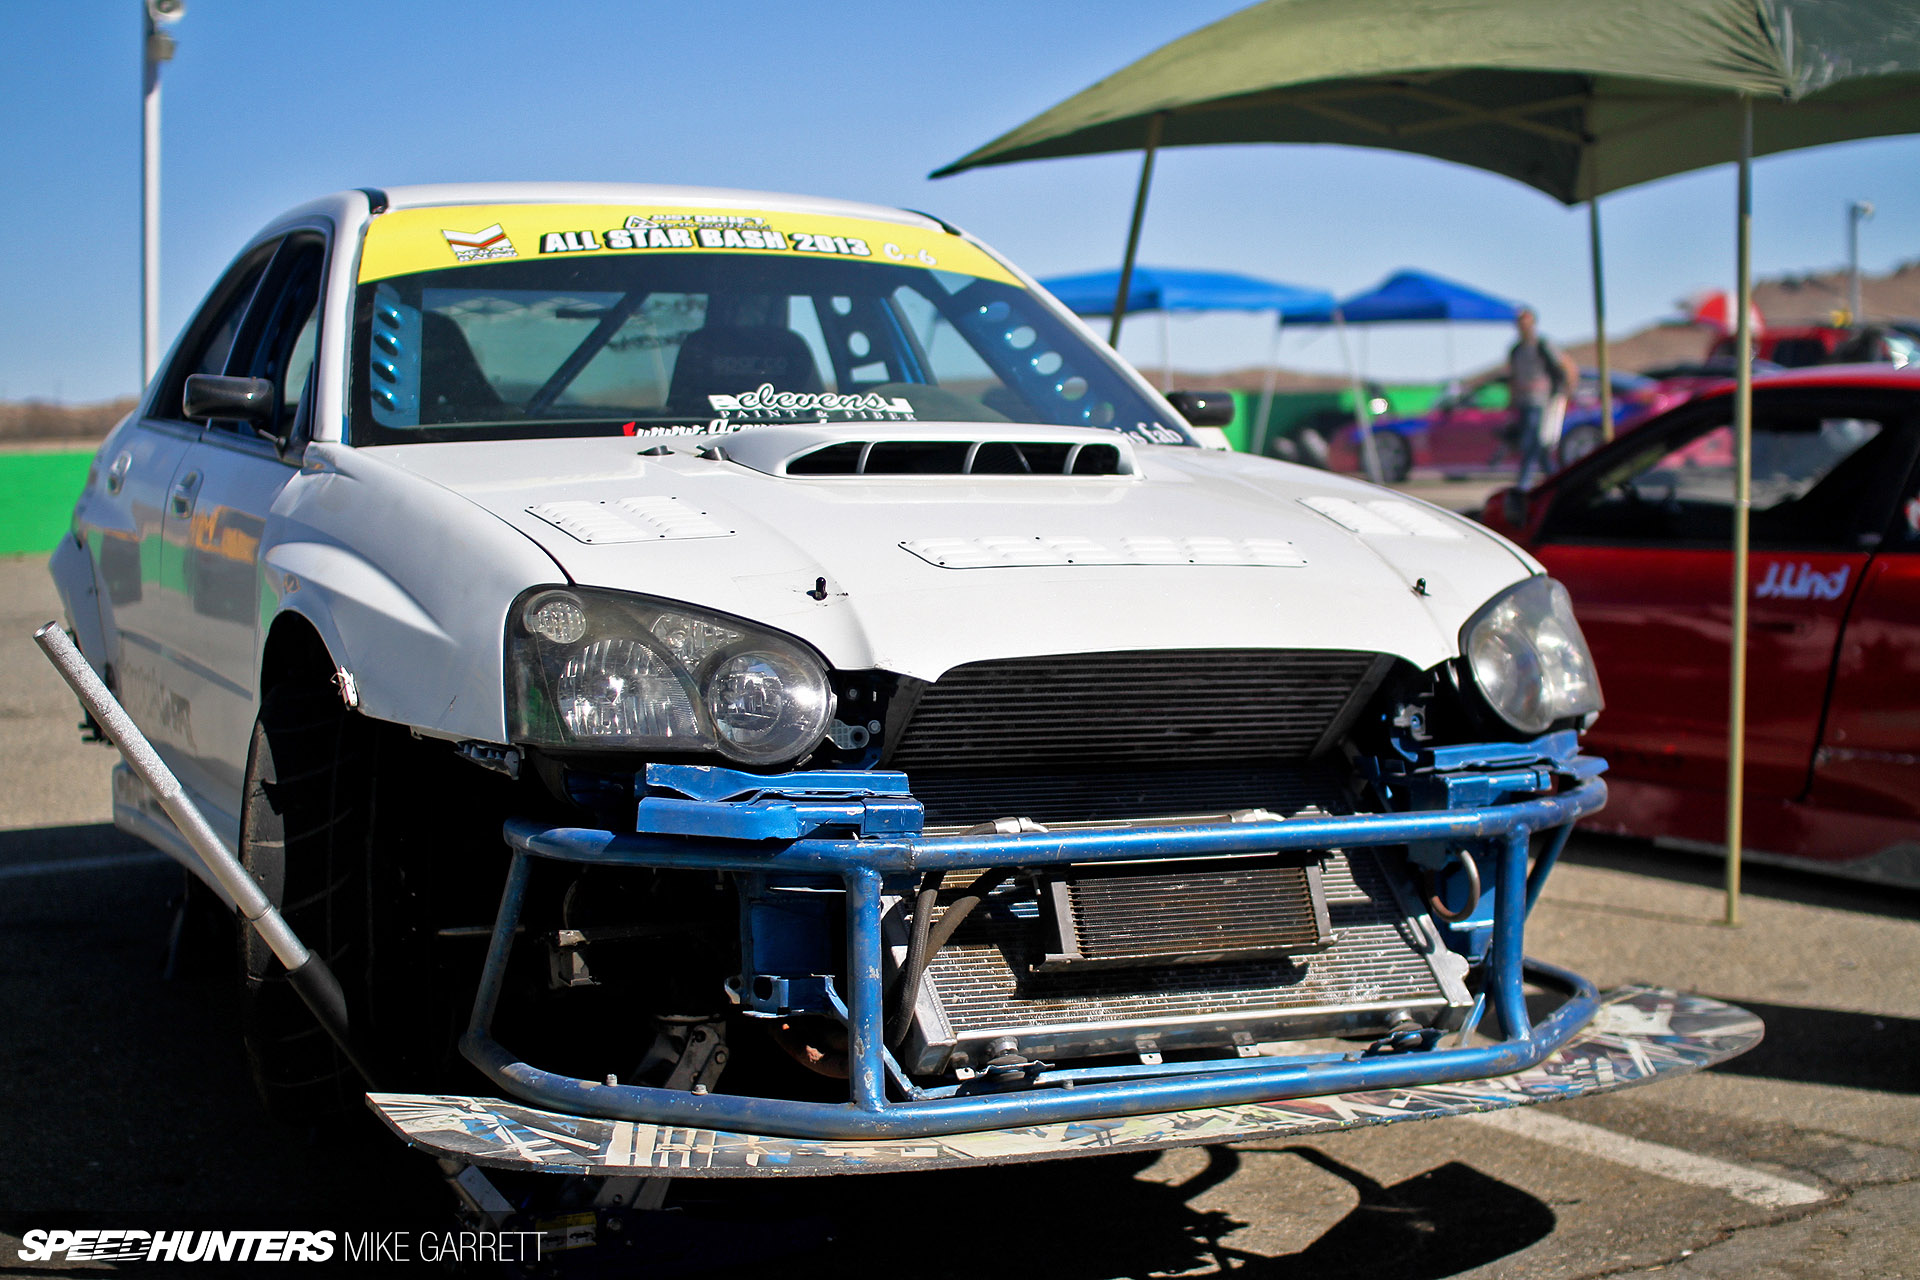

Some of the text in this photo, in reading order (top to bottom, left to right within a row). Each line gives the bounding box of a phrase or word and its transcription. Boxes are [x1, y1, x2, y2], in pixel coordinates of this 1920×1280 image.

[694, 215, 766, 226] DRIFT
[539, 228, 872, 257] ALL STAR BASH 2013
[737, 382, 887, 410] elevens
[719, 410, 918, 421] PAINT & FIBER
